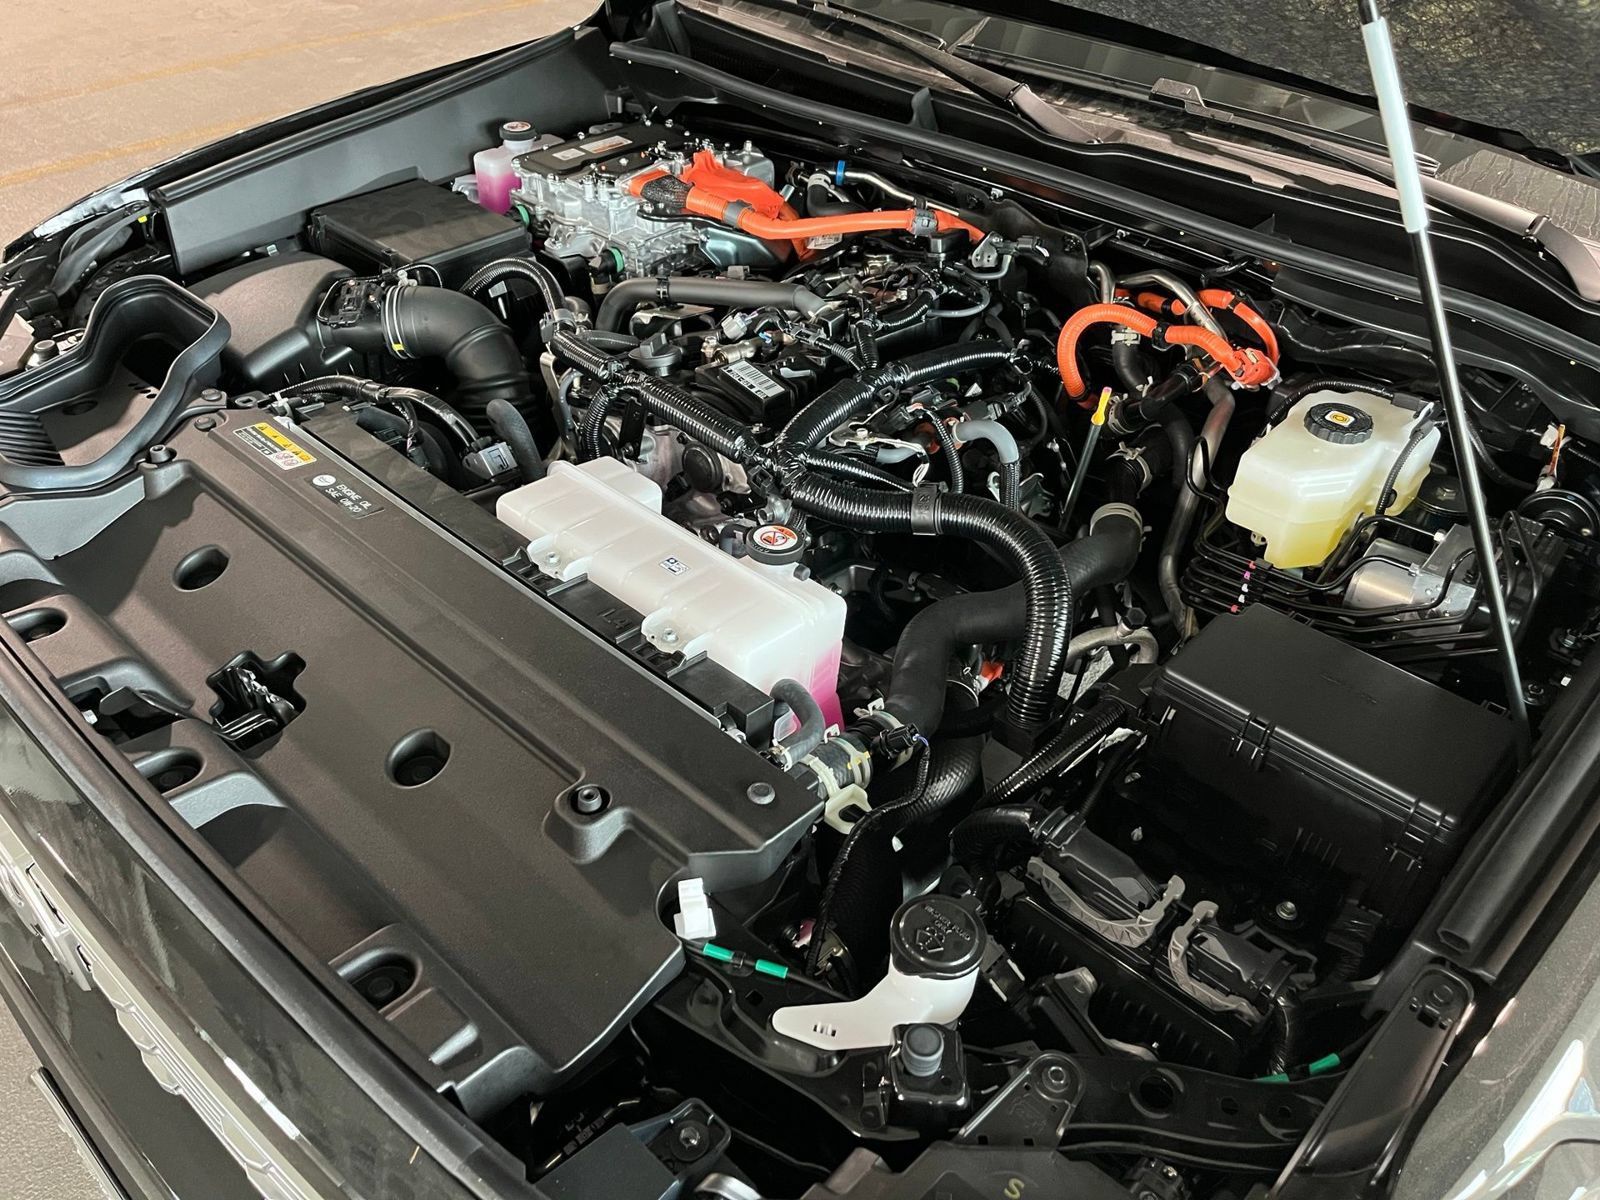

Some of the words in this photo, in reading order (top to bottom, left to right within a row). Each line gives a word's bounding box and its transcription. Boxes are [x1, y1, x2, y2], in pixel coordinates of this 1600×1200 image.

[325, 487, 343, 499] SAE
[340, 498, 362, 513] 0W-20
[336, 484, 362, 501] ENGINE
[359, 500, 373, 510] OIL
[1004, 1178, 1025, 1200] S
